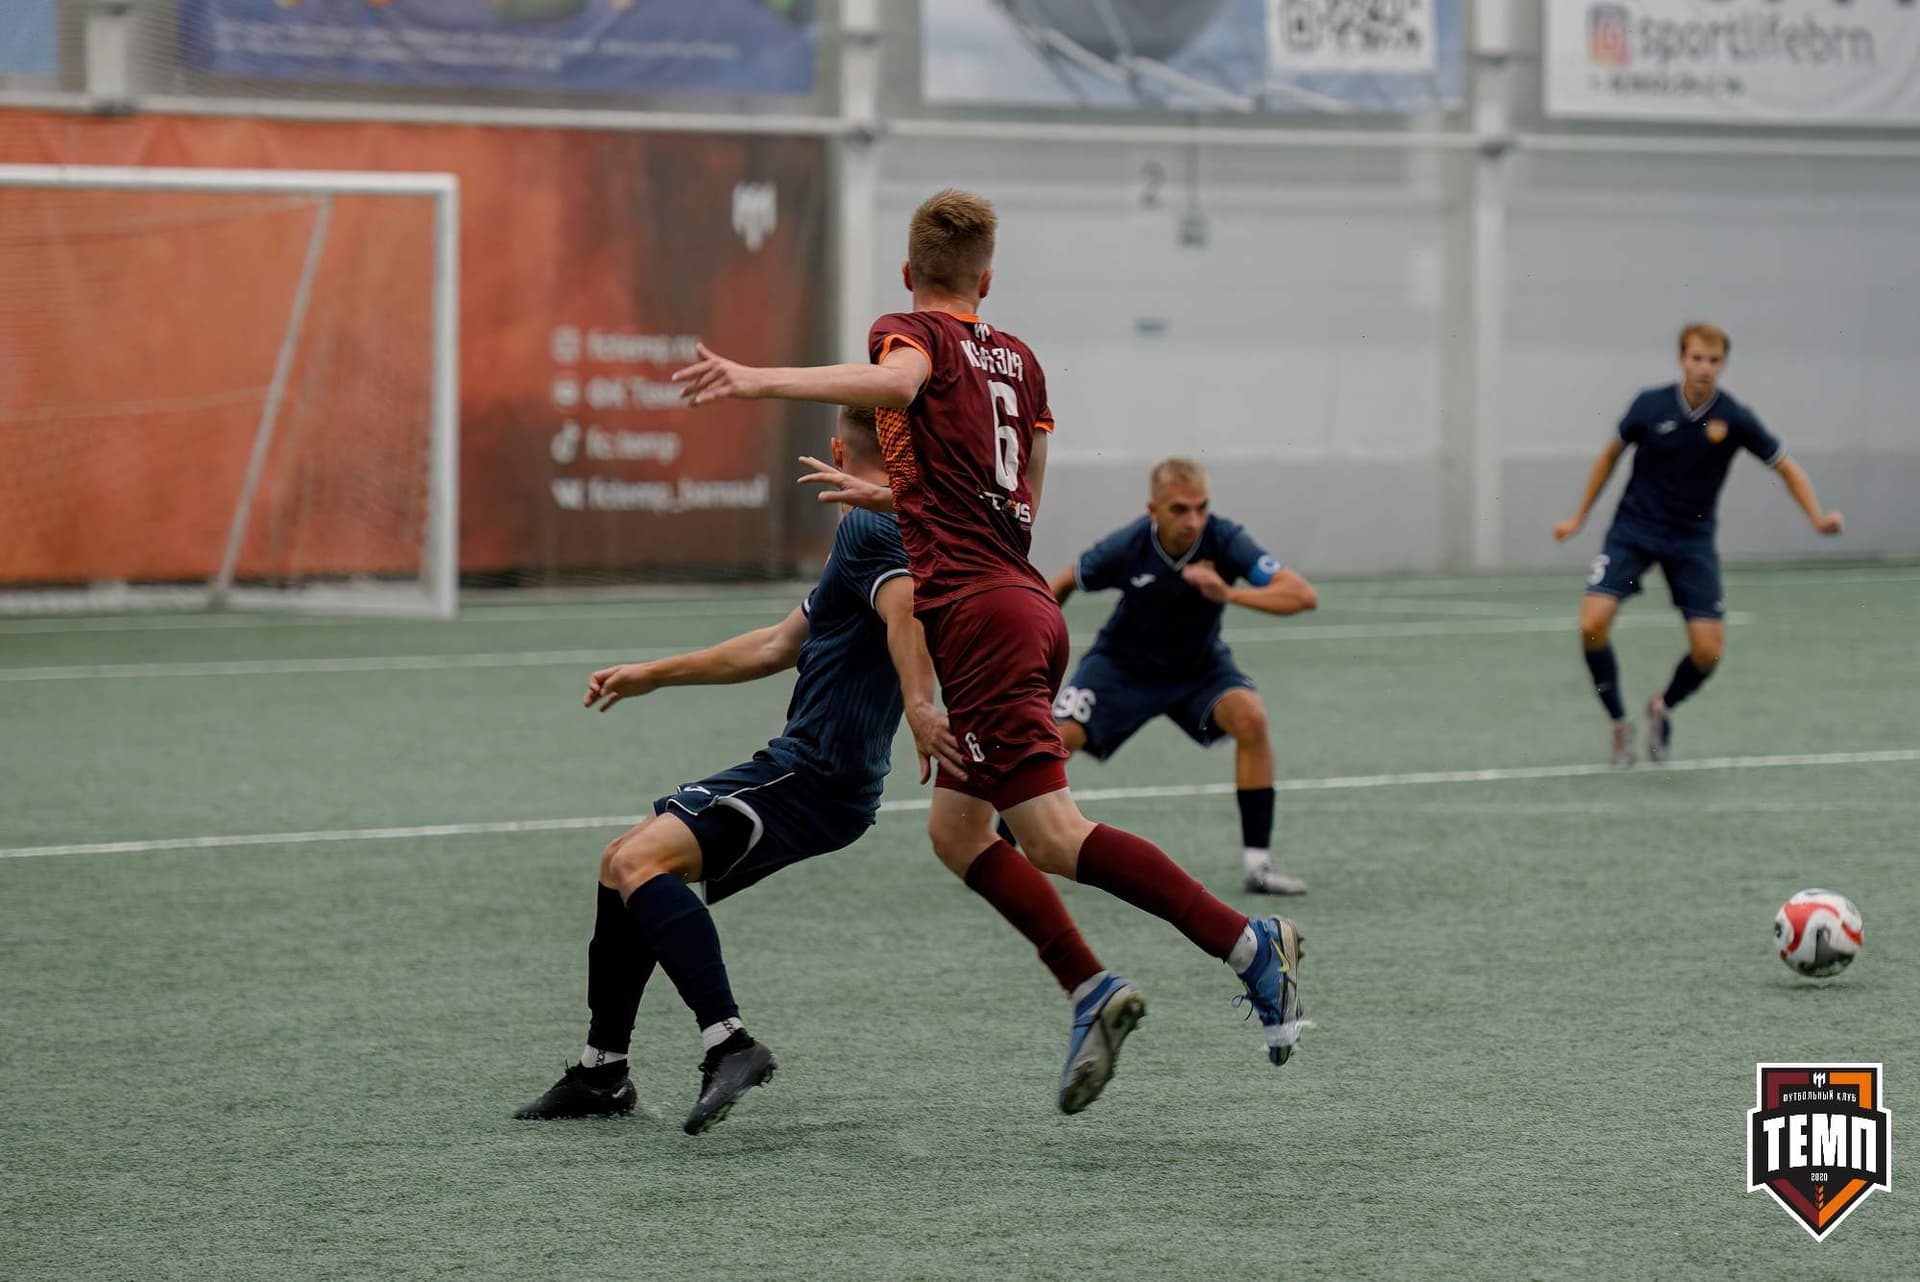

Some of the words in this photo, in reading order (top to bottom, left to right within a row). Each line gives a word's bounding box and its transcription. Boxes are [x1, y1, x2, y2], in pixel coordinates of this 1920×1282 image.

[987, 379, 1019, 492] 6
[1054, 686, 1096, 723] 96
[965, 732, 985, 762] 6
